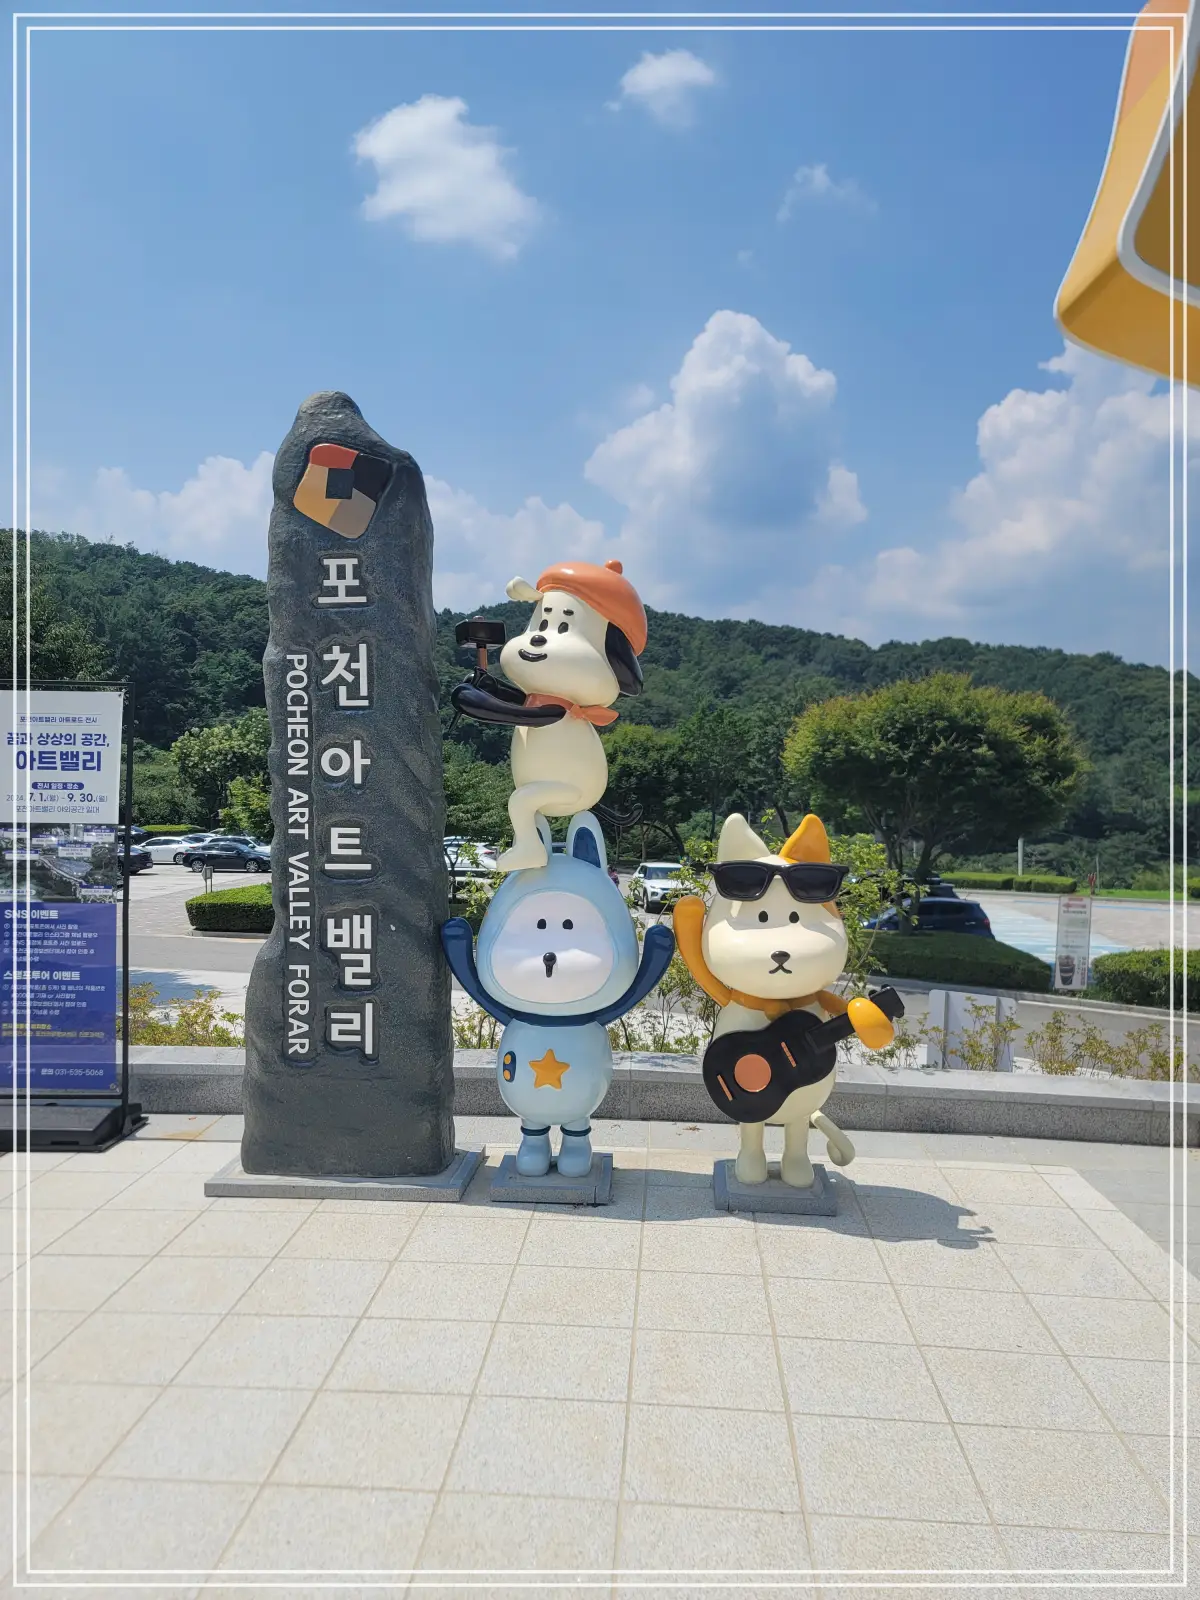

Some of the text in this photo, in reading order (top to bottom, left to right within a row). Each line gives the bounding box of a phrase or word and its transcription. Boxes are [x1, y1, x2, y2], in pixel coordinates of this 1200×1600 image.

[85, 716, 98, 724] 전시
[37, 732, 76, 746] 상상의
[81, 733, 110, 748] 공간,
[16, 750, 102, 772] 아트밸리
[317, 558, 372, 1054] 포천아트밸리
[286, 654, 311, 1055] POCHEON ART VALLEY FORAR
[4, 909, 59, 919] SNS 이벤트
[52, 971, 80, 981] 이벤트
[54, 1068, 104, 1076] 031-535-5068
